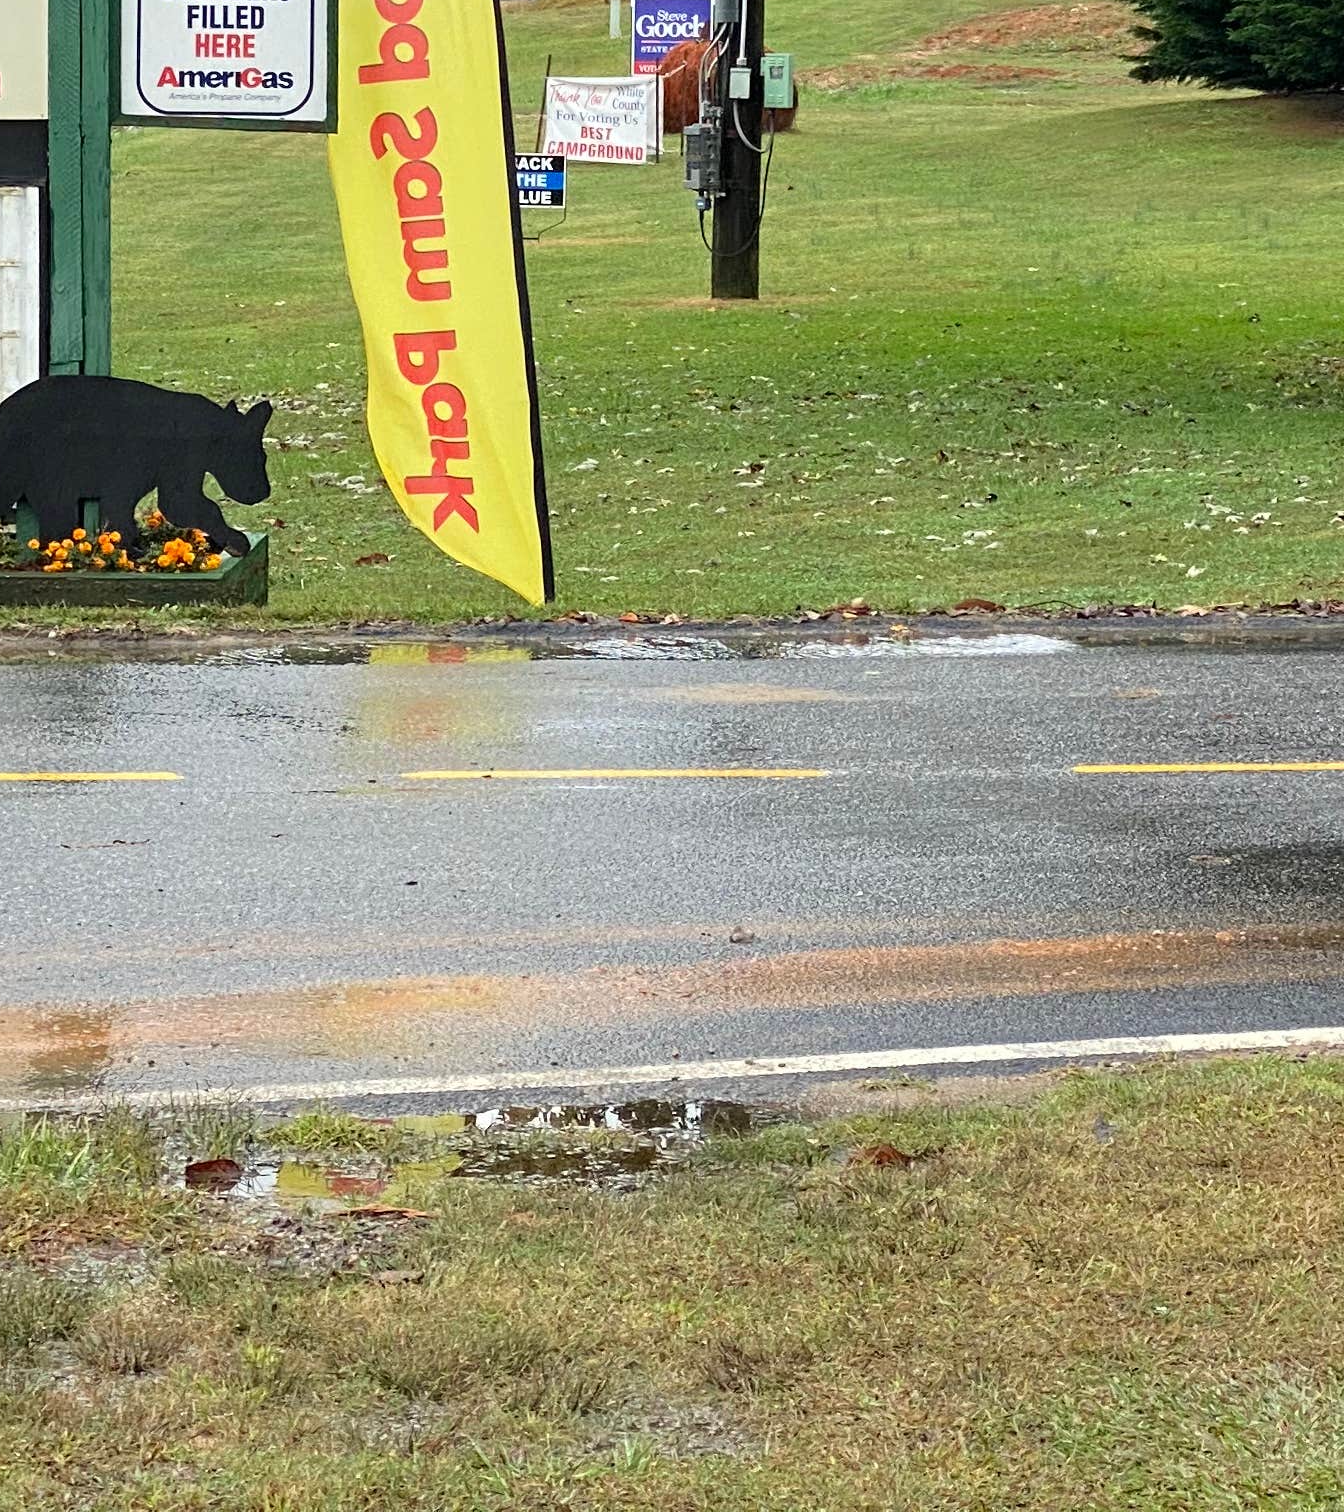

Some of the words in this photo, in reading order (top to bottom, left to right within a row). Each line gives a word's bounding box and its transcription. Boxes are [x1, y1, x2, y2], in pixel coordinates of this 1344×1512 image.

[187, 5, 265, 29] FILLED
[657, 9, 687, 22] Steve
[195, 34, 256, 58] HERE
[157, 66, 294, 89] AmeriGas
[209, 92, 243, 102] Propane
[244, 92, 281, 103] Company
[616, 86, 645, 98] White
[612, 98, 647, 115] County
[556, 110, 576, 122] For
[580, 111, 620, 127] Voting
[624, 114, 639, 126] Us
[580, 126, 613, 141] BEST
[547, 140, 644, 161] CAMPGROUND
[515, 156, 554, 171] ACK
